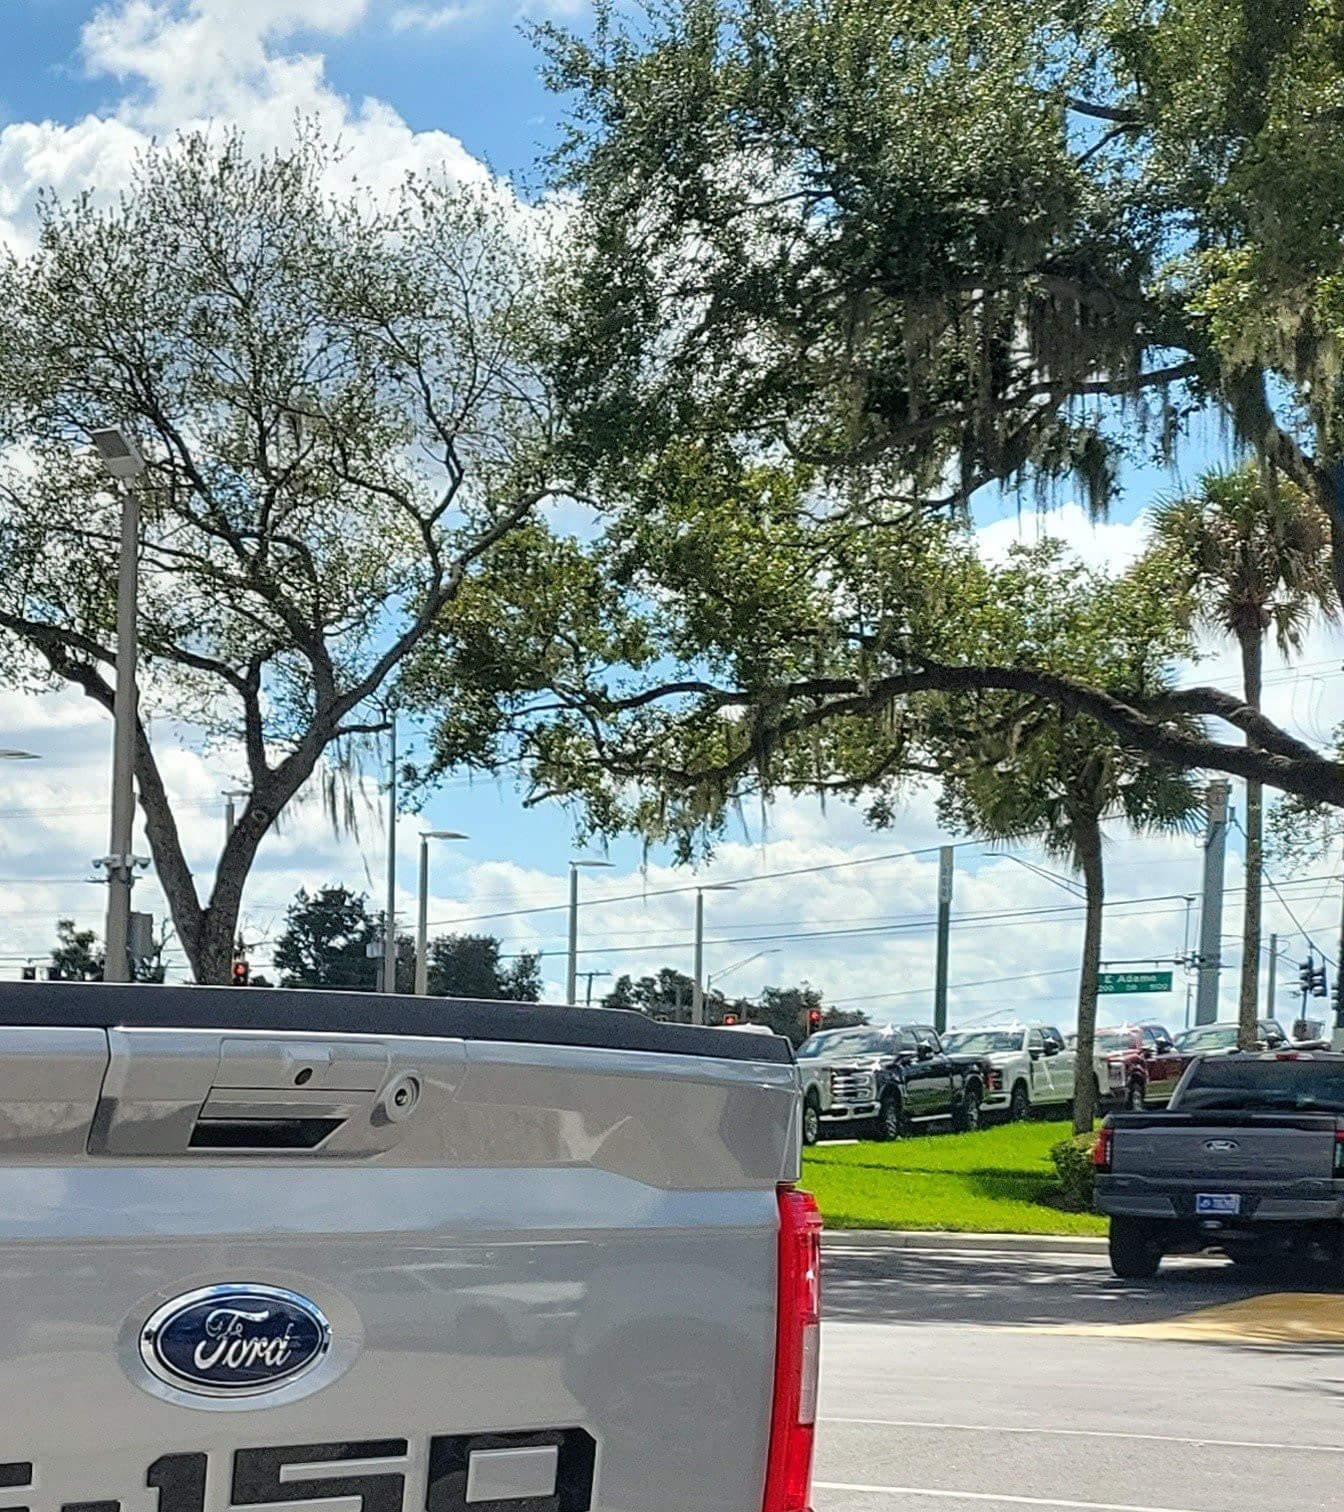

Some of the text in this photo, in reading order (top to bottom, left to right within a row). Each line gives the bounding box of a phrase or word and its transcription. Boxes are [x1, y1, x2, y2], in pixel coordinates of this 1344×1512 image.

[1105, 974, 1157, 984] E Adamo
[194, 1308, 294, 1369] Ford
